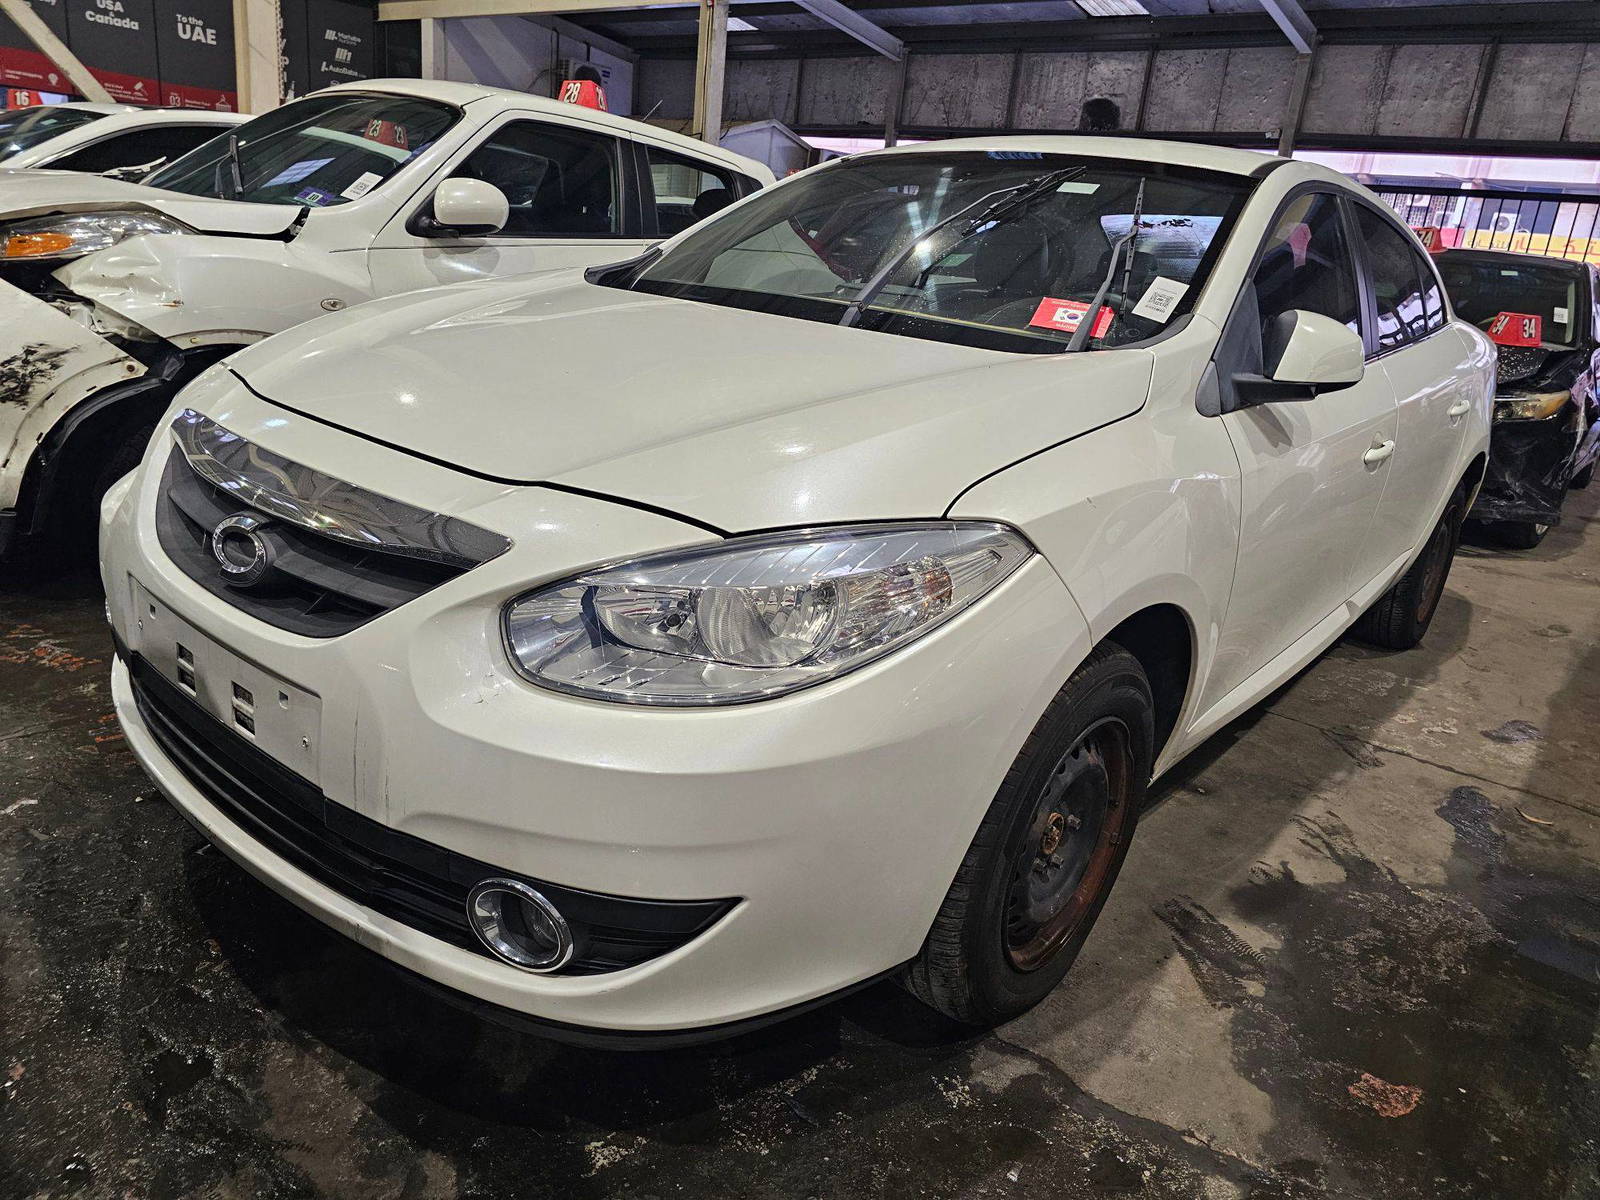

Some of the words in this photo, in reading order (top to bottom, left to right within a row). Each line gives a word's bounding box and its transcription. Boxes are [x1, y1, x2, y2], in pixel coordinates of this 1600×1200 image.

[96, 0, 125, 13] USA
[85, 10, 140, 30] Canada
[176, 13, 188, 23] To
[188, 16, 204, 26] the
[177, 22, 217, 45] UAE
[15, 91, 30, 106] 16
[563, 82, 581, 104] 28
[1522, 318, 1536, 338] 34
